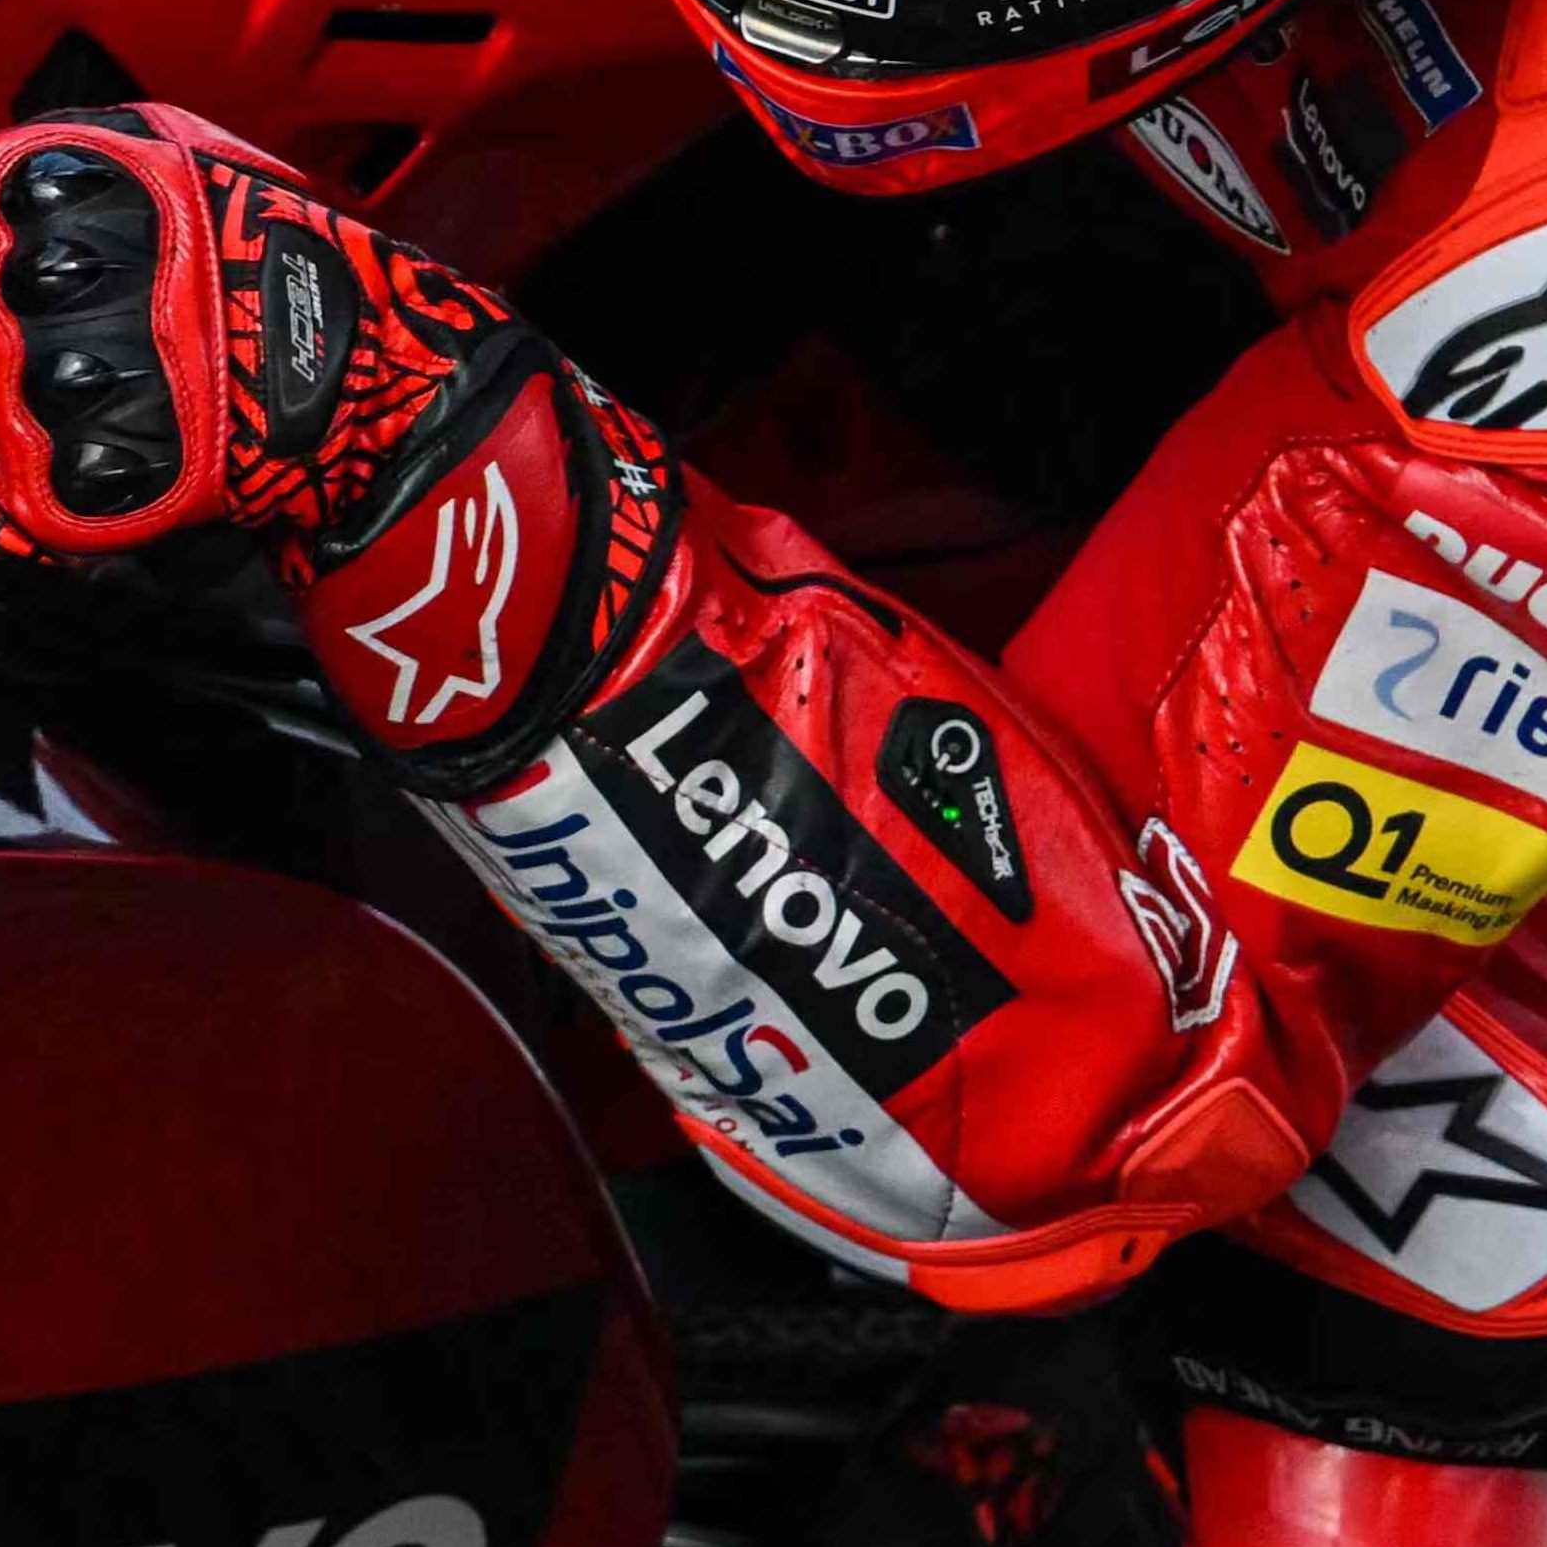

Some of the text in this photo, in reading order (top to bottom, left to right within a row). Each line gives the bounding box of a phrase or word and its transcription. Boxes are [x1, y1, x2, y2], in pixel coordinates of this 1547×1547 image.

[1298, 76, 1369, 212] Lenovo
[624, 690, 930, 1042] Lenovo
[1269, 780, 1427, 902] Q1
[1394, 885, 1494, 930] Masking
